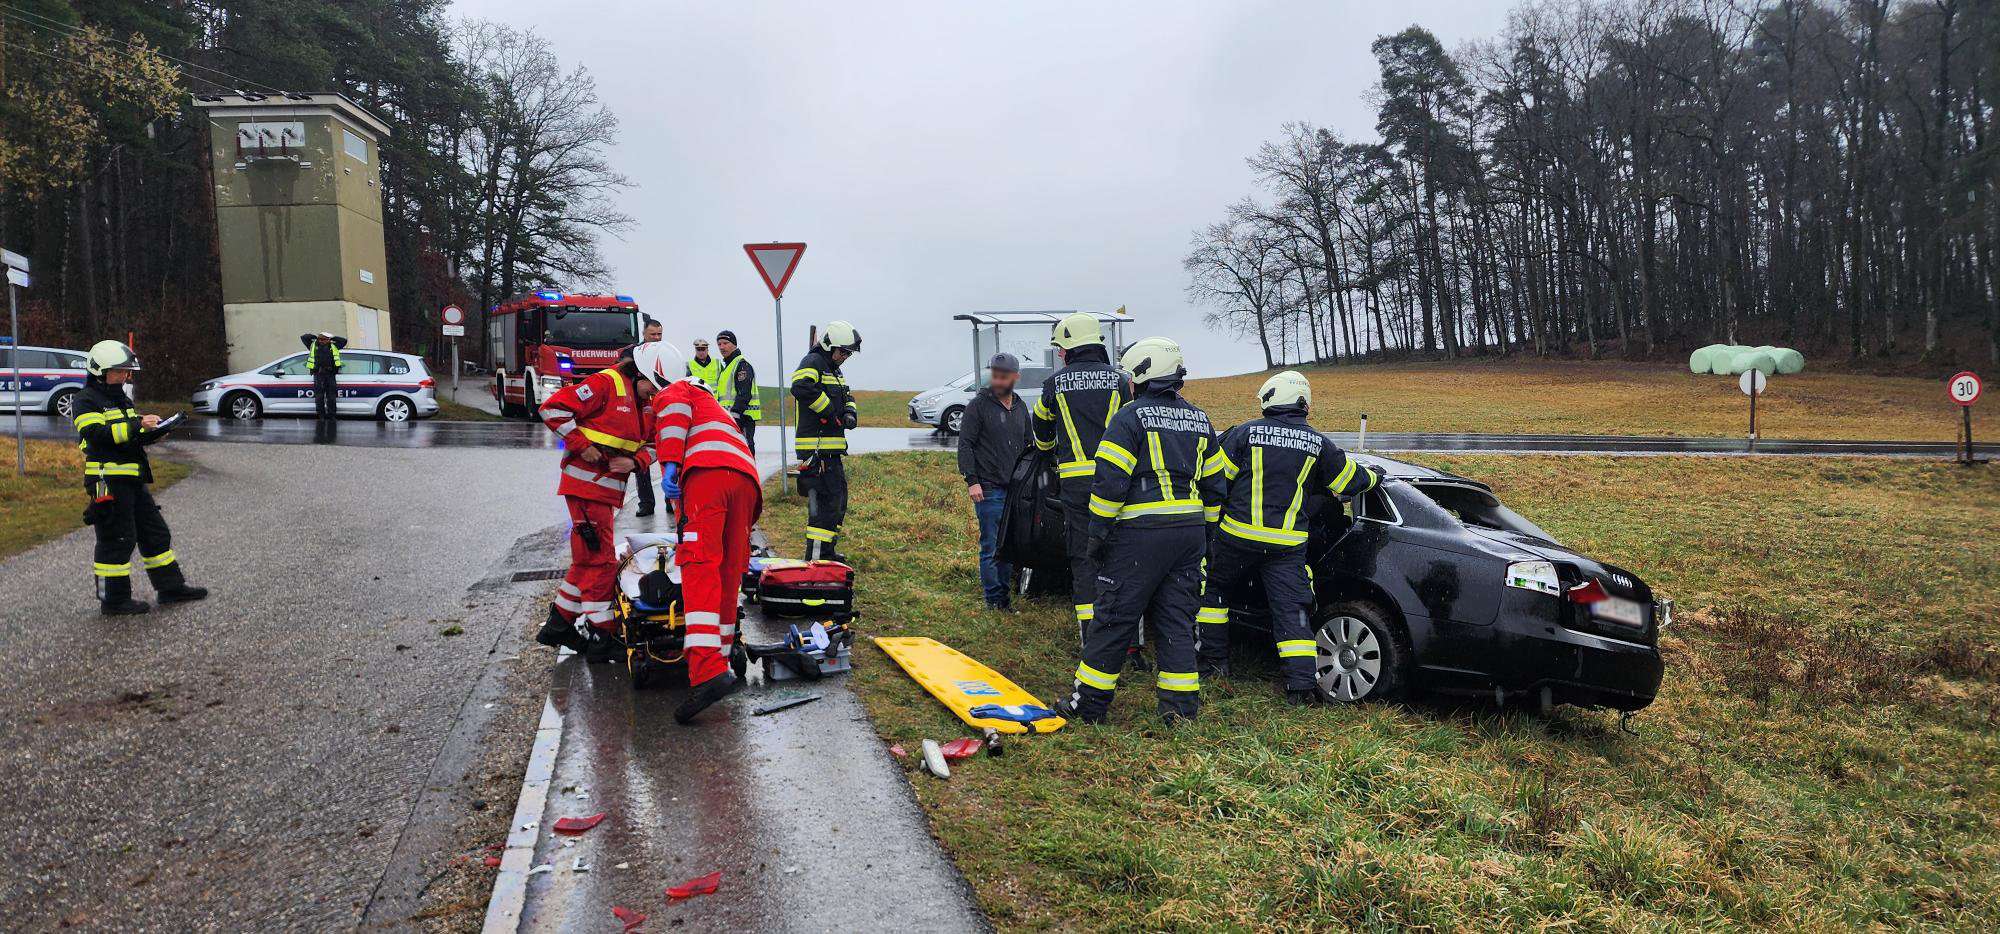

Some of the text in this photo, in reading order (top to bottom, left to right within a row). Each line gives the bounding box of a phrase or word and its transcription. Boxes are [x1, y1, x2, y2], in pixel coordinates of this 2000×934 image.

[571, 350, 619, 358] FEUERWEHR
[297, 389, 349, 398] POEI
[1957, 381, 1973, 396] 30
[1135, 405, 1208, 422] FEUERWEHR
[1141, 416, 1210, 434] GALLNEUKIRCHEN
[1249, 425, 1323, 446] FEUERWEHR
[1248, 433, 1322, 456] GALLNEUKIRCHEN
